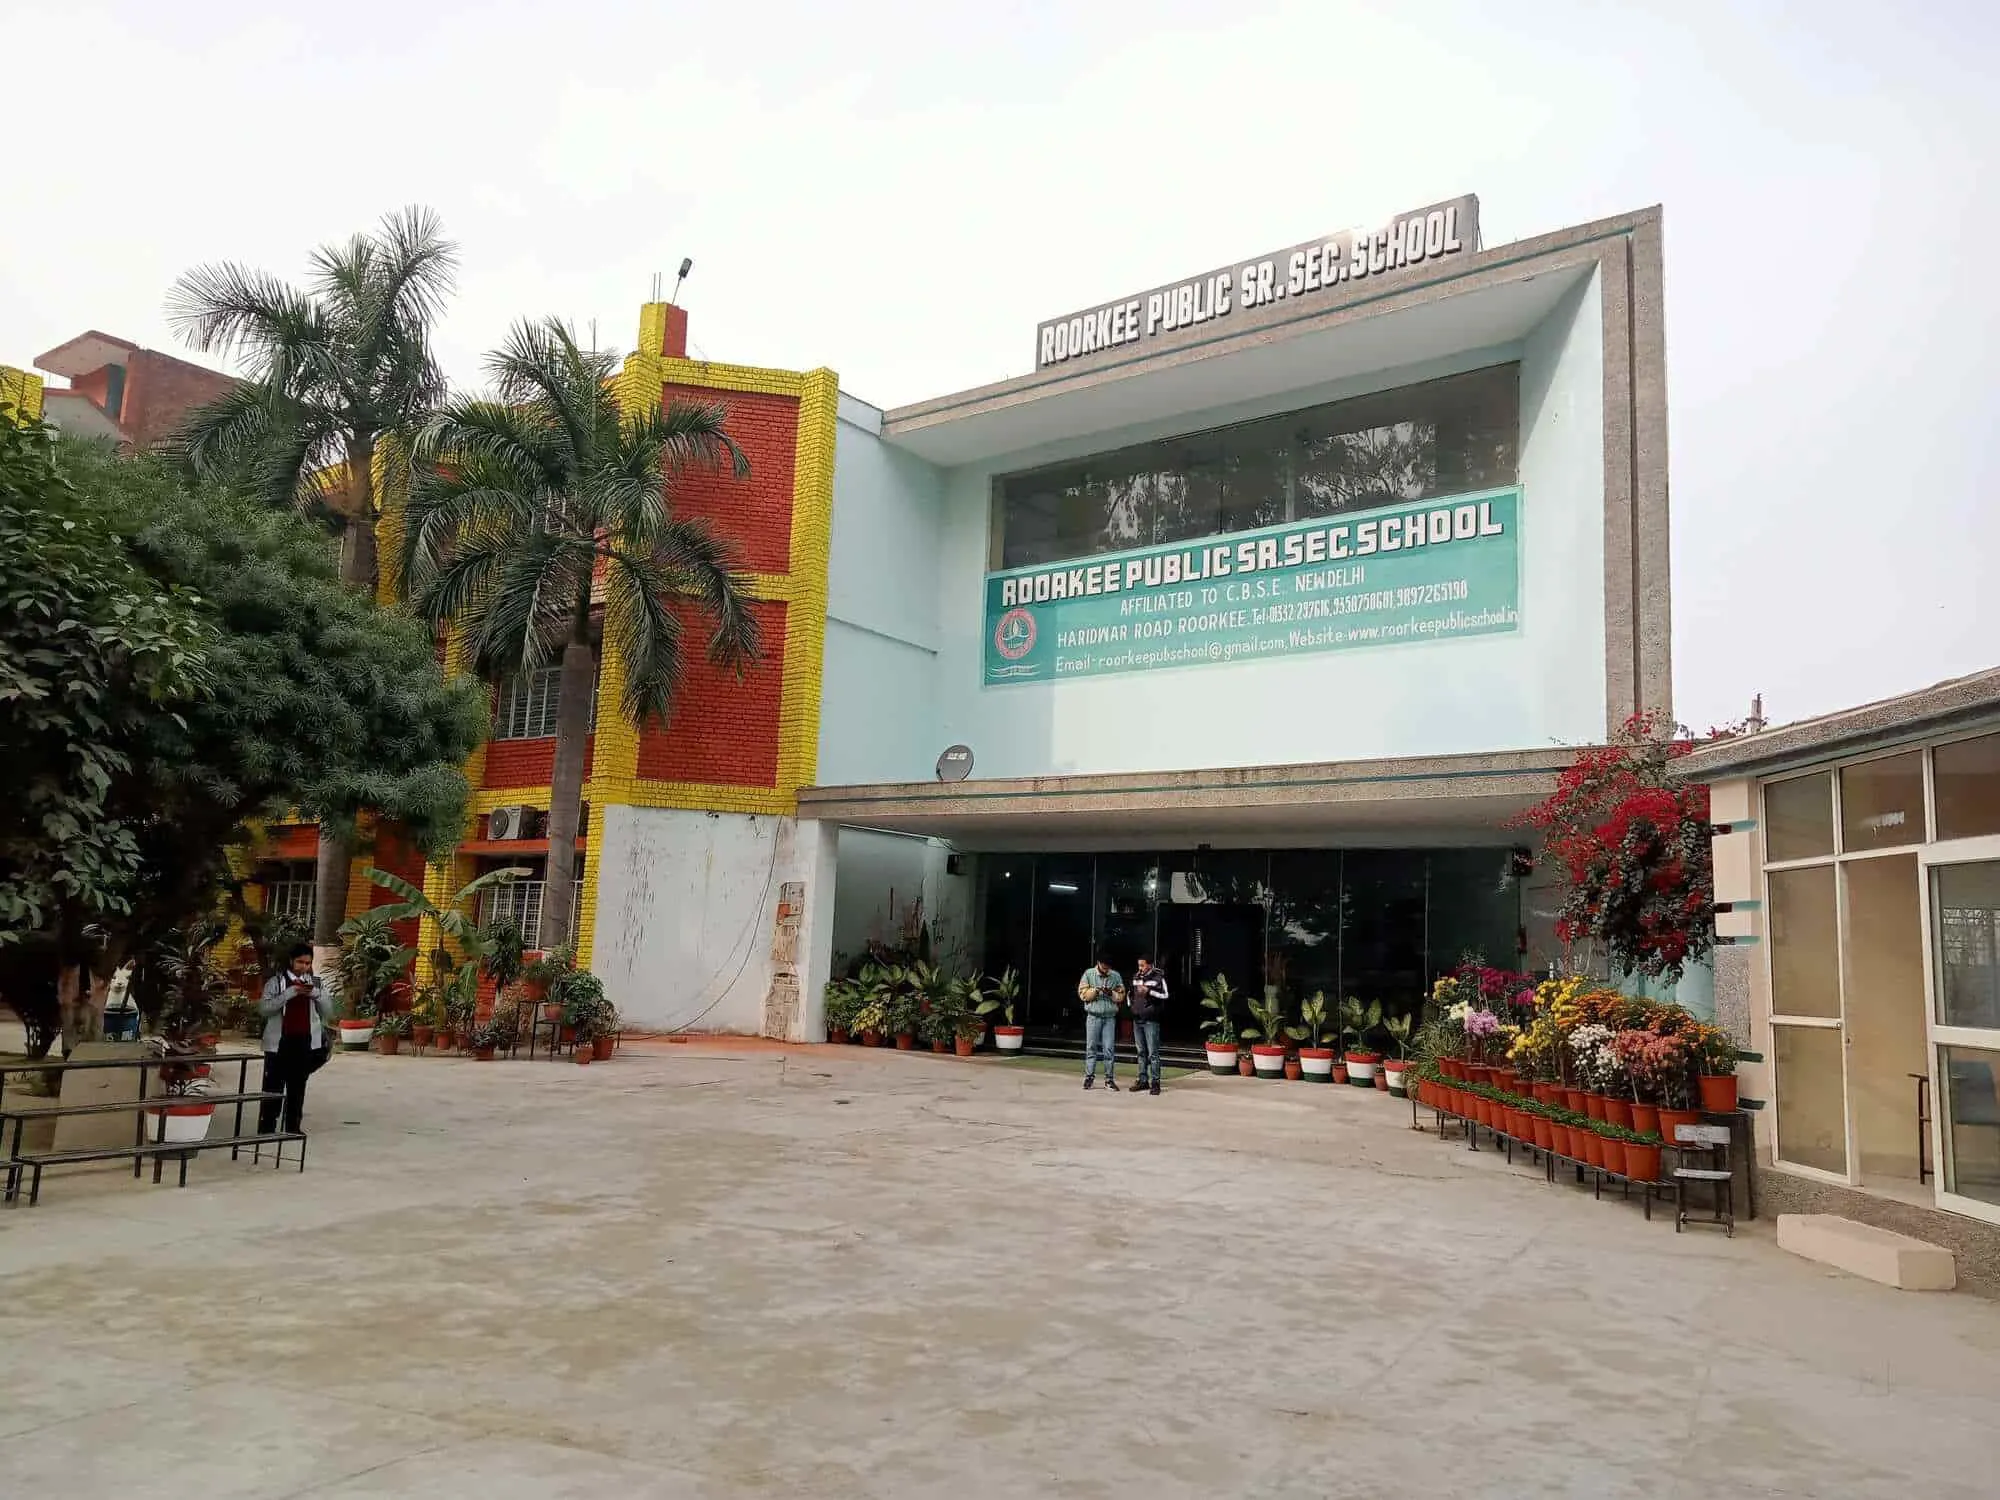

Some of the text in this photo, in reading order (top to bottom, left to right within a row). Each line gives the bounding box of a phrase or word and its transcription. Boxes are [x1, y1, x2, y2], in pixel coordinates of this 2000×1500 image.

[1041, 300, 1141, 364] ROORKEE
[1147, 272, 1233, 337] PUBLIC
[1002, 562, 1121, 607] ROORKEE
[1126, 546, 1232, 589] PUBLIC
[1120, 591, 1193, 616] AFFILIATED
[1201, 587, 1217, 605] TO
[1057, 625, 1128, 649] HARIDWAR
[1134, 619, 1173, 640] ROAD
